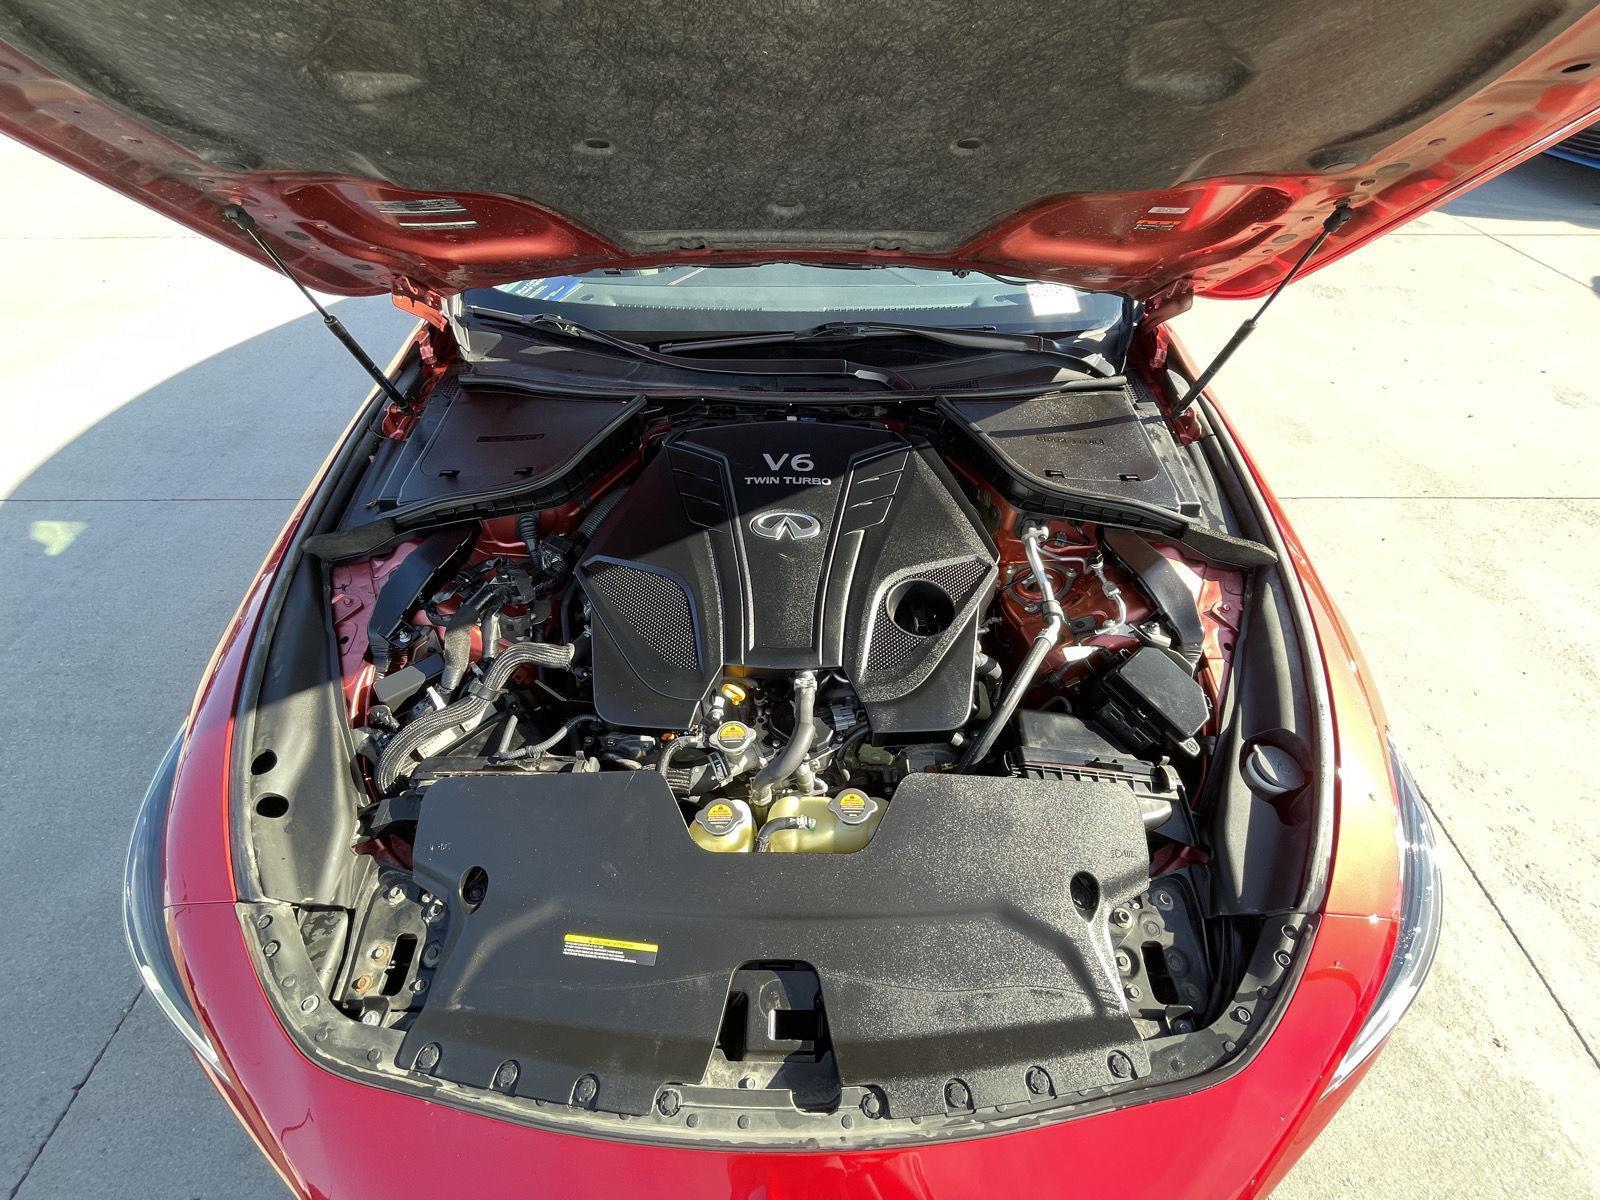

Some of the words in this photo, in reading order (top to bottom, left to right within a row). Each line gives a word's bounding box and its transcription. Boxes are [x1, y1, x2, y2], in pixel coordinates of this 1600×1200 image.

[762, 453, 815, 472] V6
[744, 476, 780, 485] TWIN
[783, 476, 832, 486] TURBO
